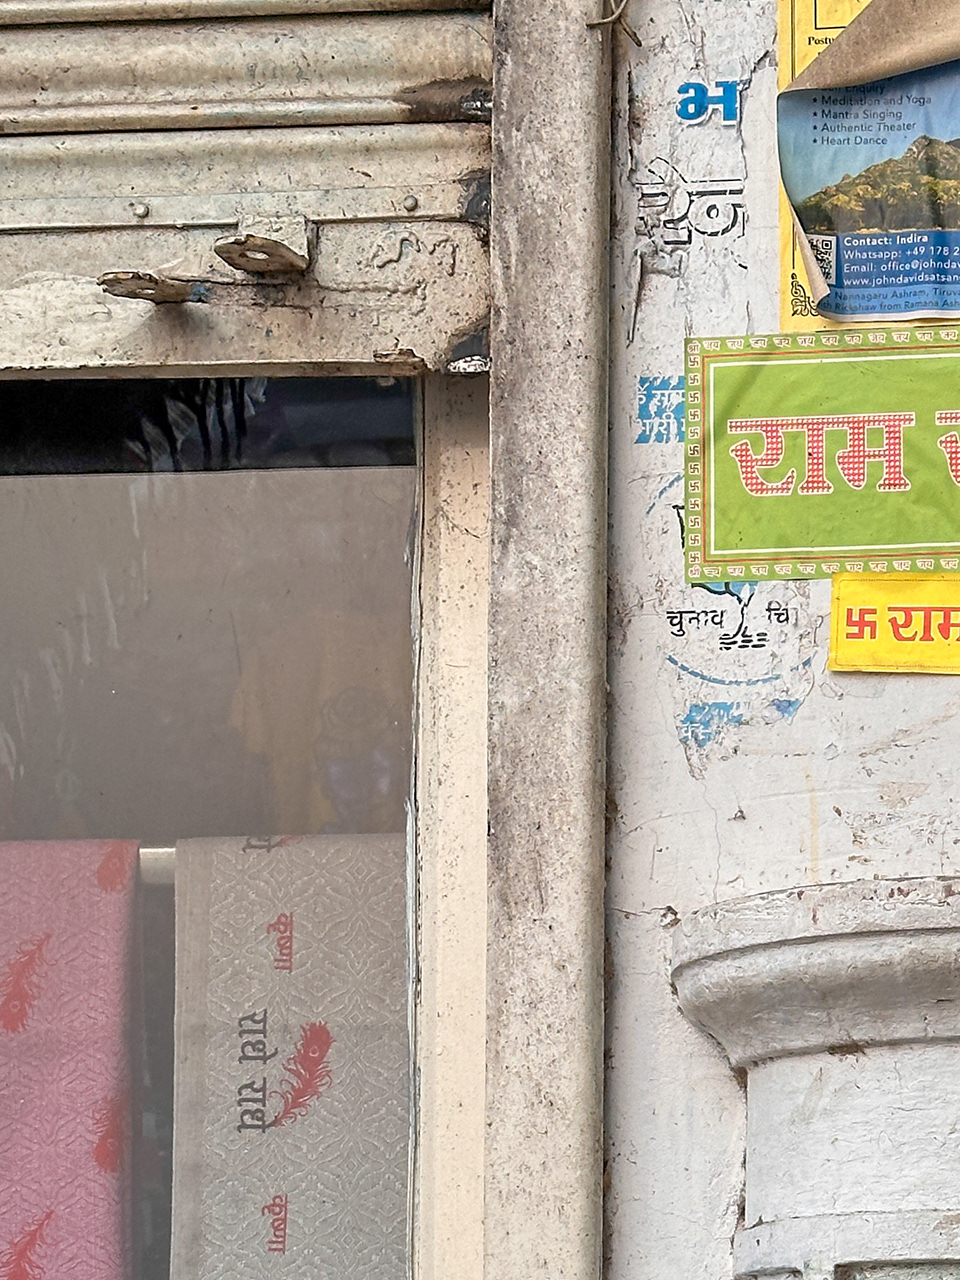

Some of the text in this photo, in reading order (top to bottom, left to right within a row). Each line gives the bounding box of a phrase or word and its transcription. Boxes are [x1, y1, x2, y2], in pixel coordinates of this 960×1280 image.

[808, 36, 834, 46] Postu
[821, 94, 932, 107] Meditation and Yoga
[821, 109, 903, 121] Mantra Singing
[821, 121, 917, 133] Authentic Theater
[821, 135, 888, 146] Heart Dance
[843, 234, 929, 247] Contact: Indira
[843, 249, 902, 261] Whatsapp:
[905, 246, 926, 257] +49
[930, 246, 949, 256] 178
[844, 263, 877, 273] Email:
[891, 288, 929, 298] Ashram,
[880, 301, 901, 311] from
[727, 410, 916, 498] राम
[766, 600, 798, 625] चि
[267, 912, 294, 975] कृष्णा
[236, 1008, 278, 1134] राधे राधे
[262, 1193, 288, 1255] कृष्णा
